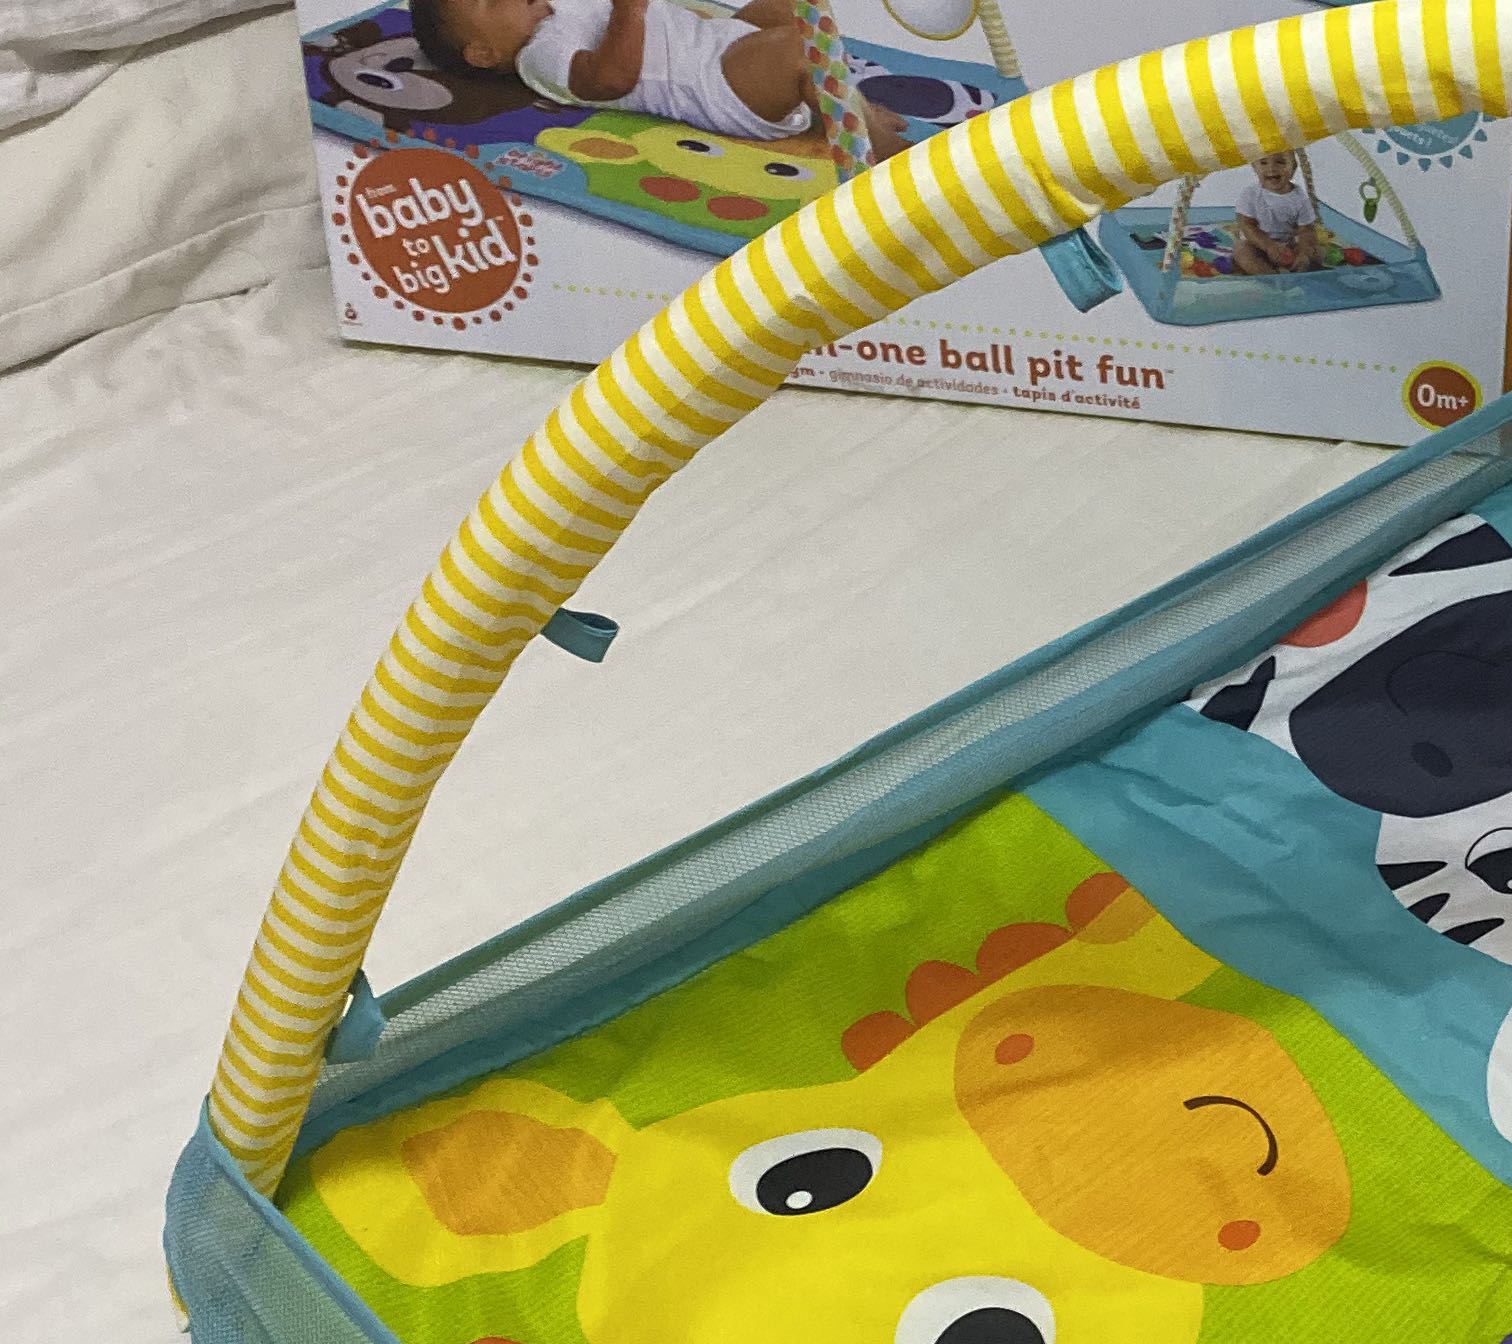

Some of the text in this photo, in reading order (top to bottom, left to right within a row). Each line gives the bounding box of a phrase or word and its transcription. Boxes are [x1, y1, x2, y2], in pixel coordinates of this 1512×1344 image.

[356, 177, 484, 239] baby
[391, 218, 518, 294] big kid
[401, 238, 431, 257] to
[896, 374, 912, 387] de
[1013, 386, 1056, 403] tapis
[939, 338, 1015, 375] ball
[1027, 349, 1084, 386] pit
[1096, 354, 1165, 389] fun
